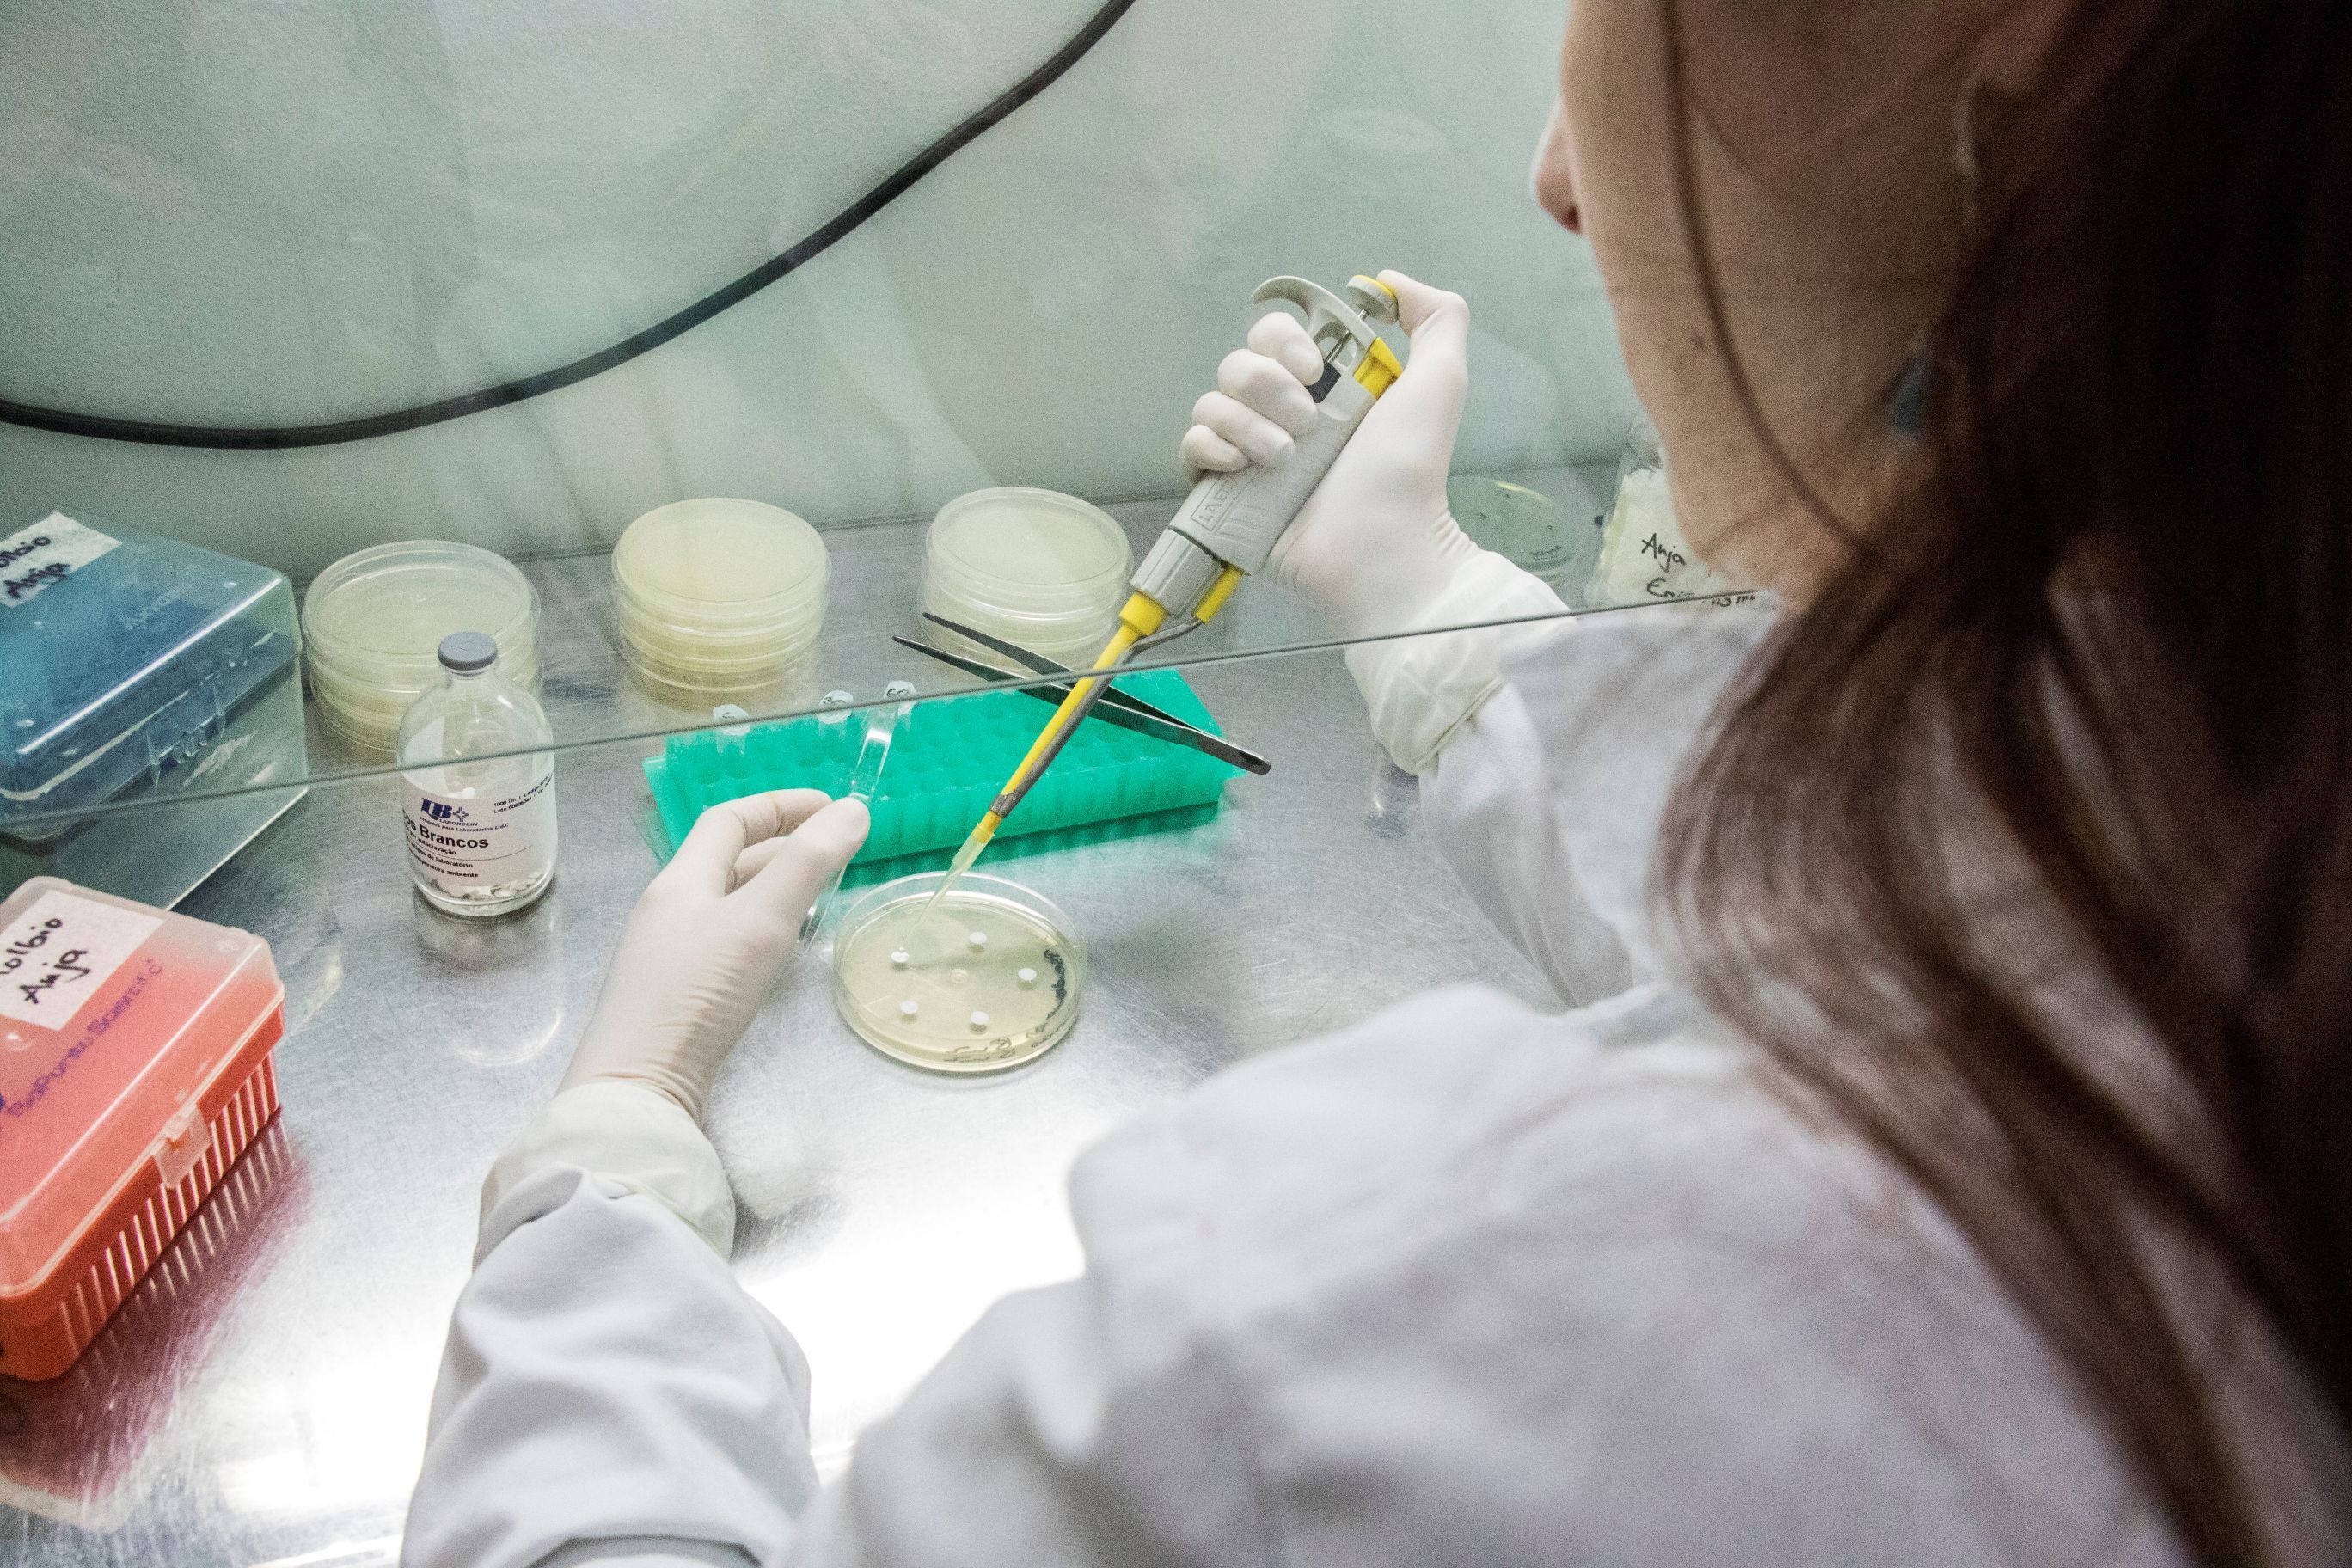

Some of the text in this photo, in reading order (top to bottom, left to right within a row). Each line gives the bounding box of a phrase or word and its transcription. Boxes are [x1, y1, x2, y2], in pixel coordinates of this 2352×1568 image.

[1640, 532, 1687, 573] Anja
[3, 563, 70, 600] Anja
[420, 824, 489, 848] Brancos
[439, 818, 479, 827] LABORCLIN
[435, 856, 474, 868] laboratório
[446, 869, 479, 878] ambiente
[0, 918, 64, 976] olbio
[19, 950, 91, 1005] Anja
